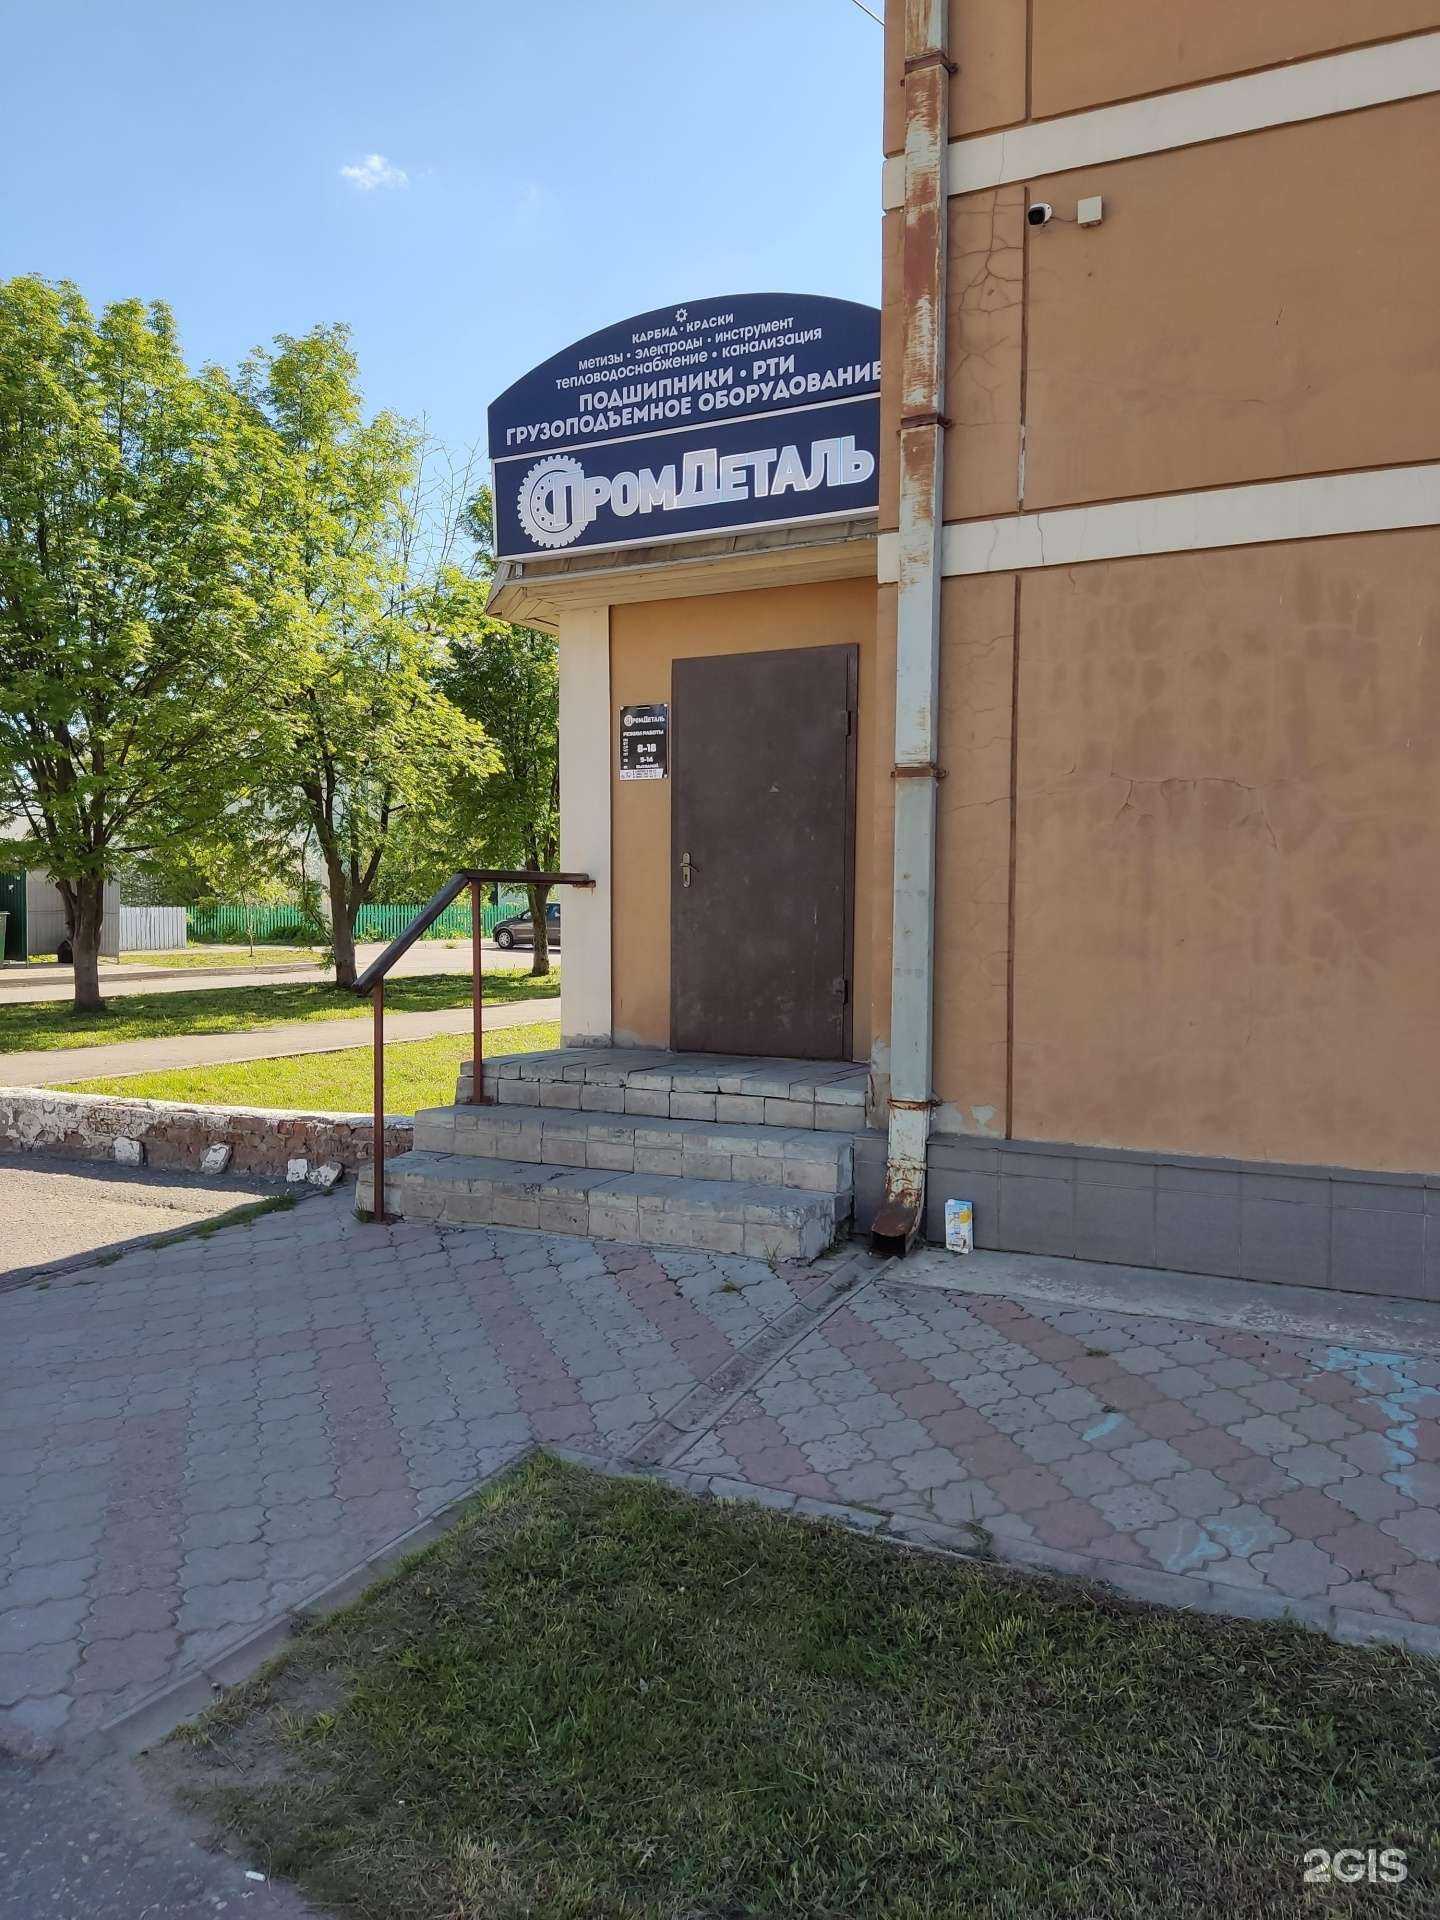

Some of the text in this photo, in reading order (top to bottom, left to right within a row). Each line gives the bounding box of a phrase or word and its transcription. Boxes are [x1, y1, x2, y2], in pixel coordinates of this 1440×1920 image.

[632, 313, 734, 344] КАРБИД КРАСКИ
[634, 337, 703, 360] электроды
[715, 316, 794, 343] инструмент
[555, 327, 822, 390] тепловодоснабжение канализация
[579, 354, 795, 412] ПОДШИПНИКИ РТИ
[506, 360, 882, 446] ГРУЗОПОДЪЕМНОЕ ОБОРУДОВАНИЕ
